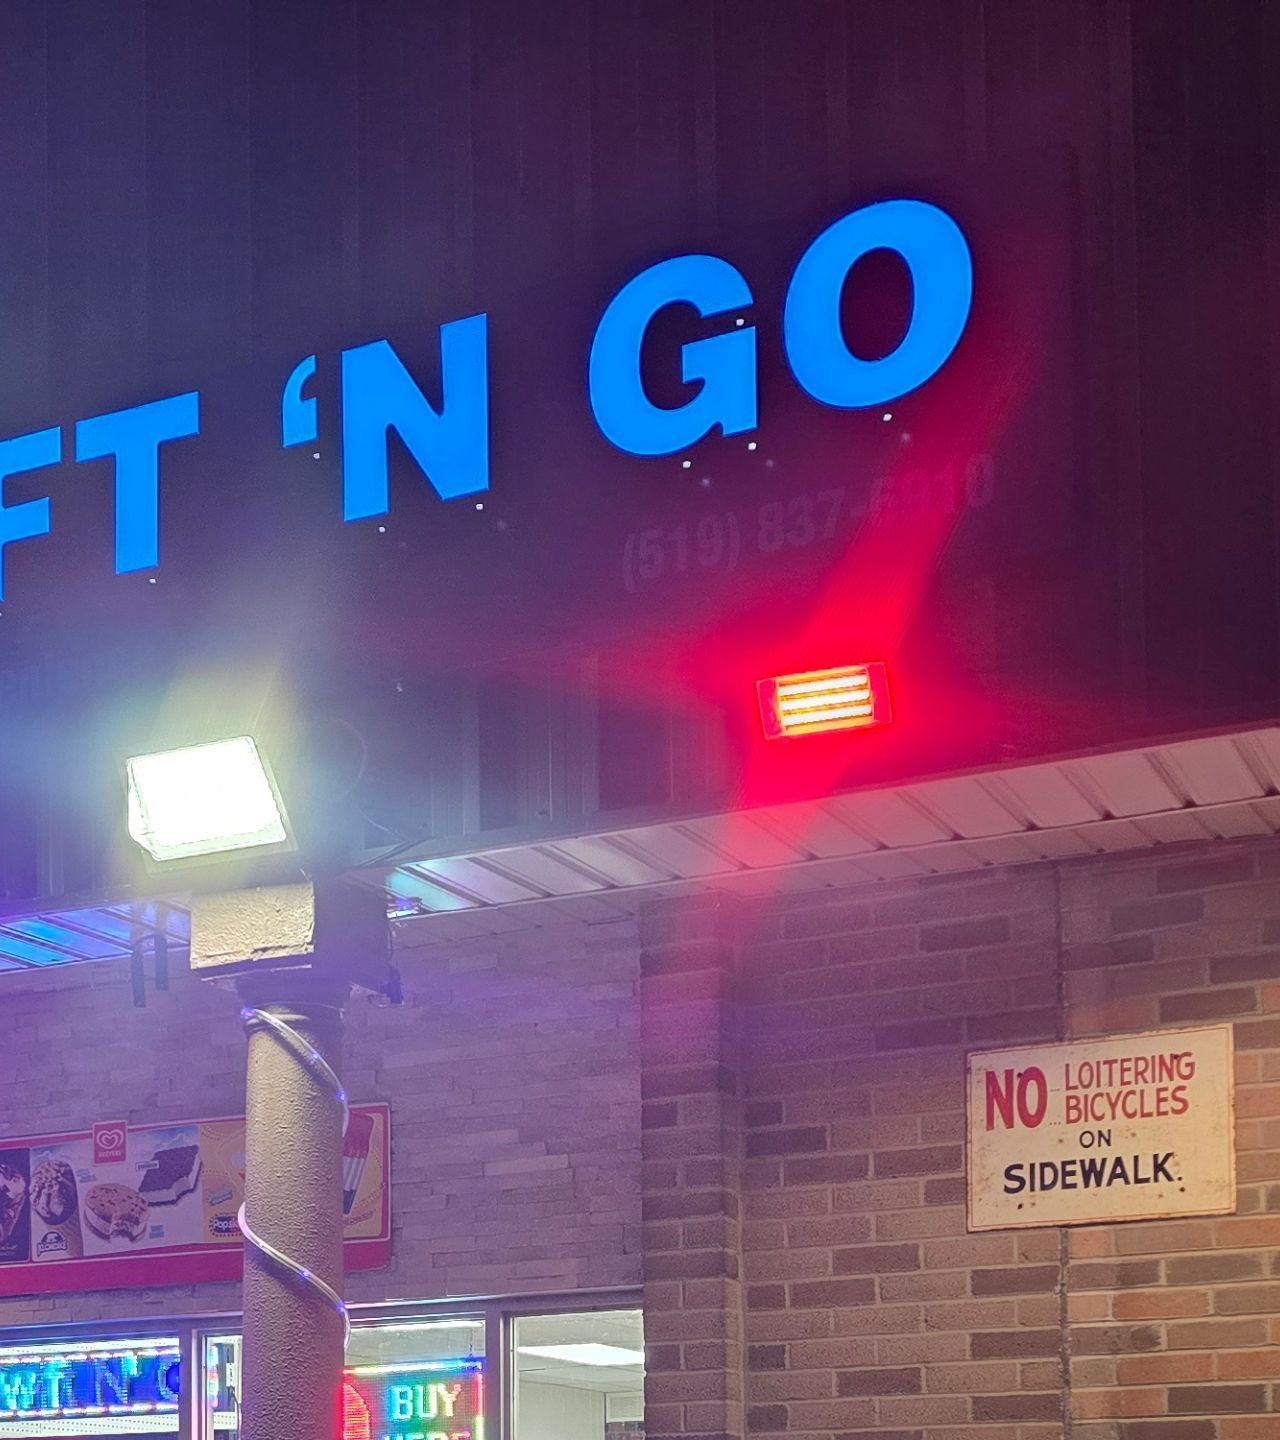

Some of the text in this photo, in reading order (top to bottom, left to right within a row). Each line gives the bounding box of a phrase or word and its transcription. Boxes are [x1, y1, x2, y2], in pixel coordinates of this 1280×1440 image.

[588, 198, 973, 458] GO
[985, 1051, 1196, 1132] NO LOITERING
[1064, 1085, 1189, 1125] BICYCLES
[1078, 1129, 1112, 1149] ON
[393, 1383, 462, 1421] BUY
